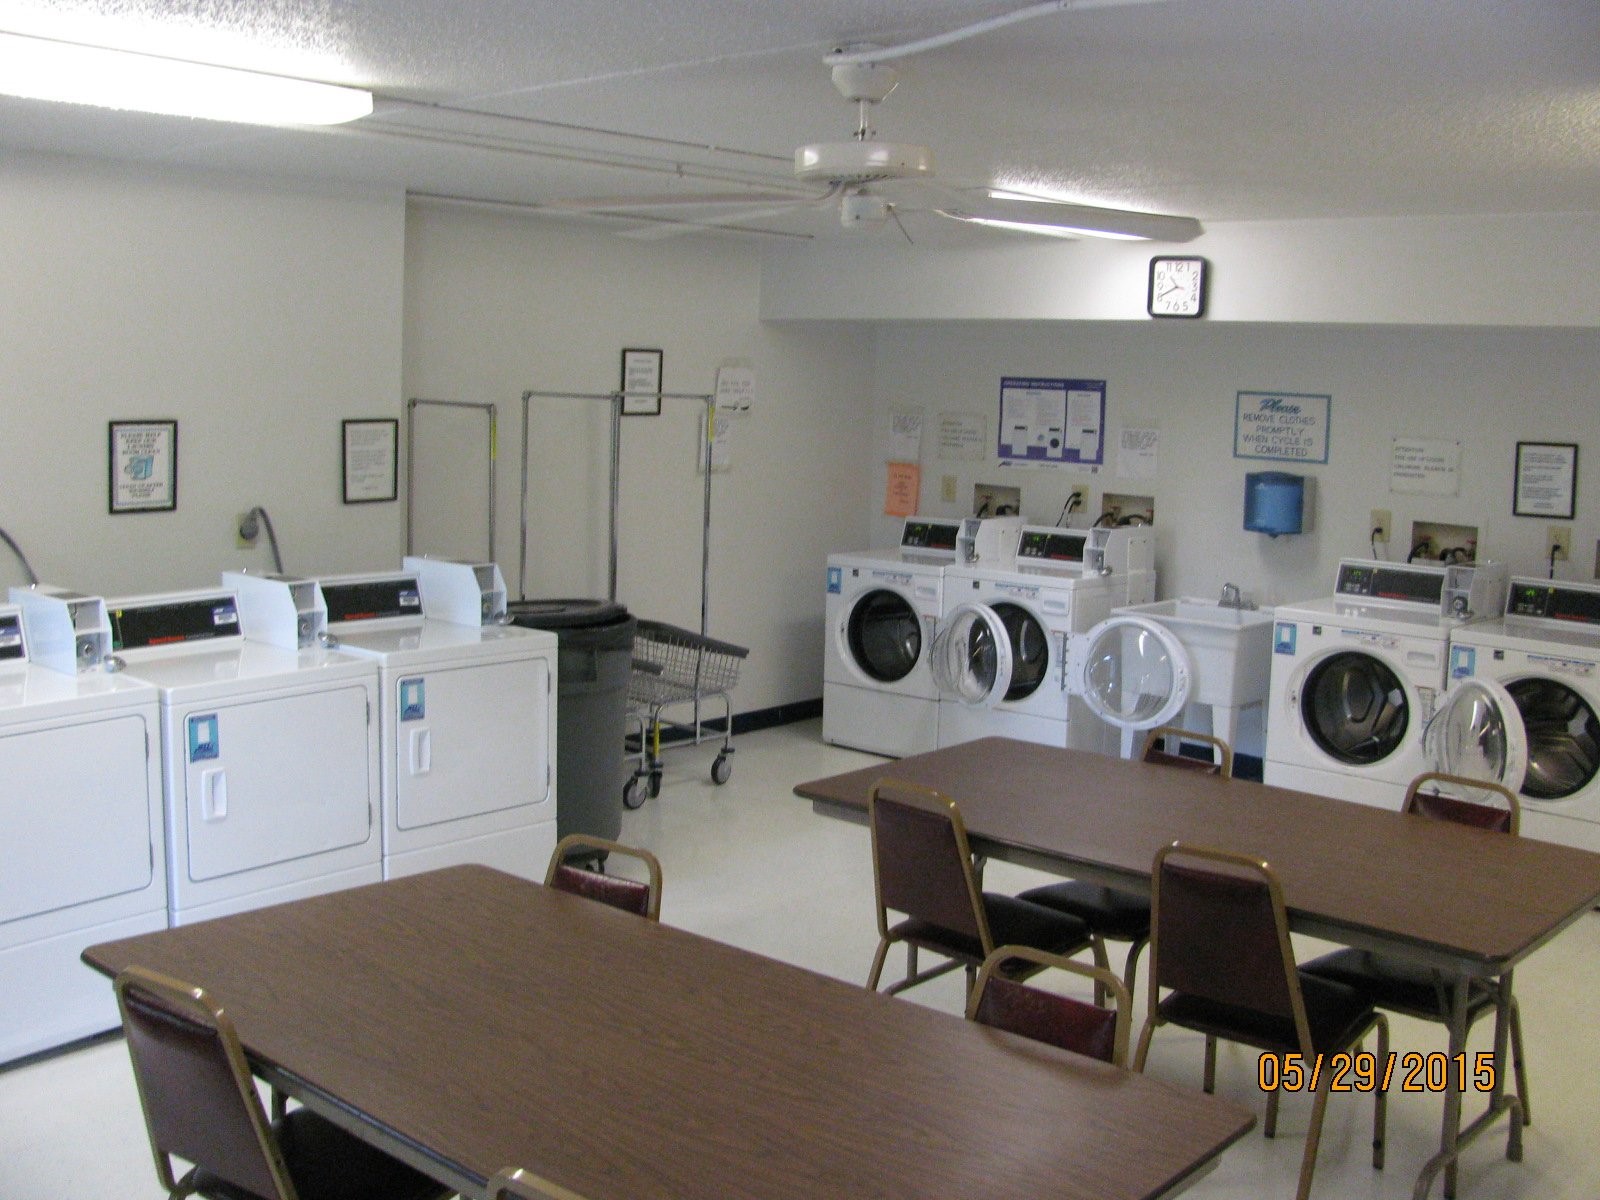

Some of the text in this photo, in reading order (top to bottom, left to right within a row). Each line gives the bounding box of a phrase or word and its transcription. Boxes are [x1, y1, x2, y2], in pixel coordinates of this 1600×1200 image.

[1175, 261, 1184, 273] 12
[1156, 271, 1166, 281] 10
[1192, 270, 1199, 281] 2
[1157, 282, 1164, 291] 9
[1191, 281, 1198, 292] 3
[1190, 292, 1197, 302] 4
[1166, 300, 1189, 312] 7 6 5
[1259, 398, 1302, 415] Please
[1243, 412, 1316, 426] REMOVE CLOTHES
[1256, 424, 1305, 436] PROMPTLY
[1242, 433, 1314, 447] WHEN CYCLE IS
[1254, 445, 1308, 457] COMPLETED
